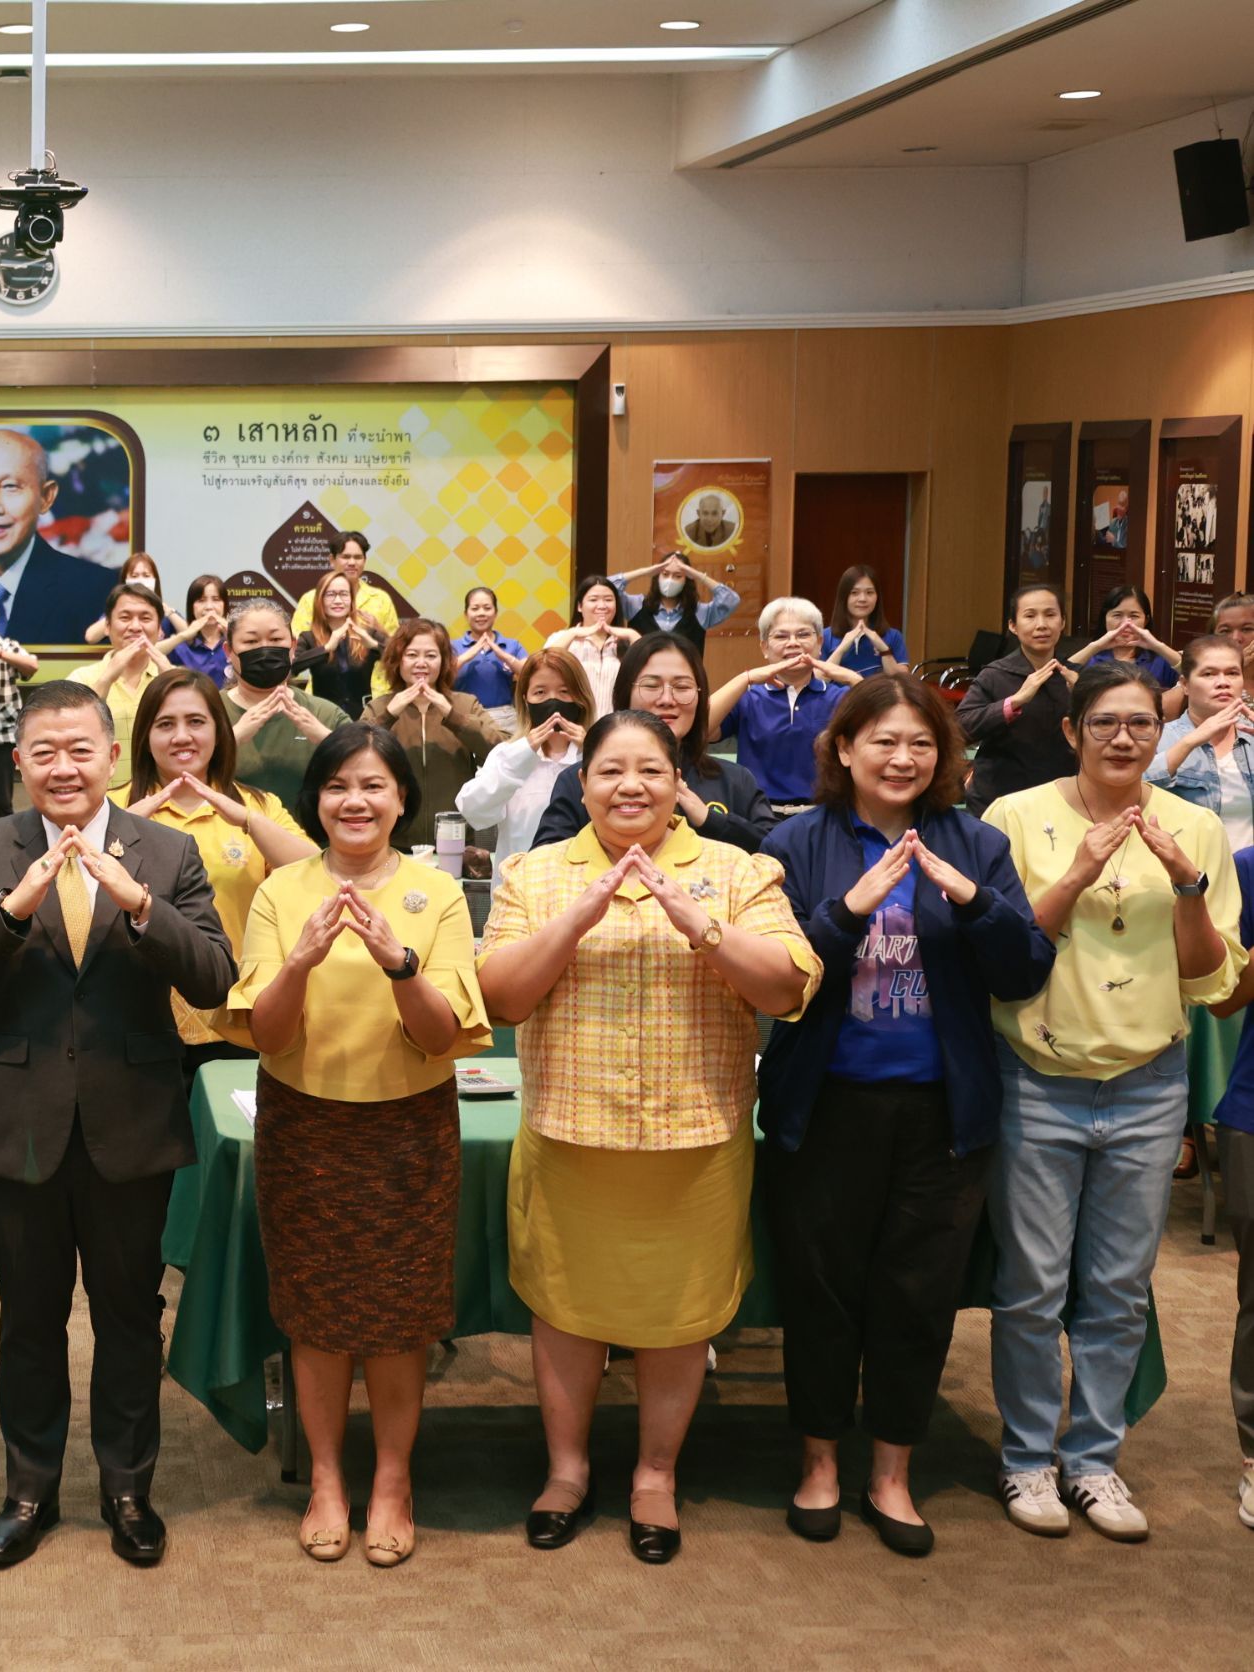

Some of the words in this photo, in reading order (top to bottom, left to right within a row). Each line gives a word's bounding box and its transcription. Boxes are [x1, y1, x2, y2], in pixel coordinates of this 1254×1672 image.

[2, 237, 10, 245] 11
[203, 426, 220, 442] ๓
[239, 413, 337, 442] เสาหลัก
[203, 450, 226, 464] ชีวิต
[233, 454, 266, 468] ชุมชน
[272, 450, 310, 464] องค์กร
[317, 451, 348, 464] สังคม
[354, 450, 411, 468] มนุษยชาติ
[226, 588, 273, 597] วามสามารถ
